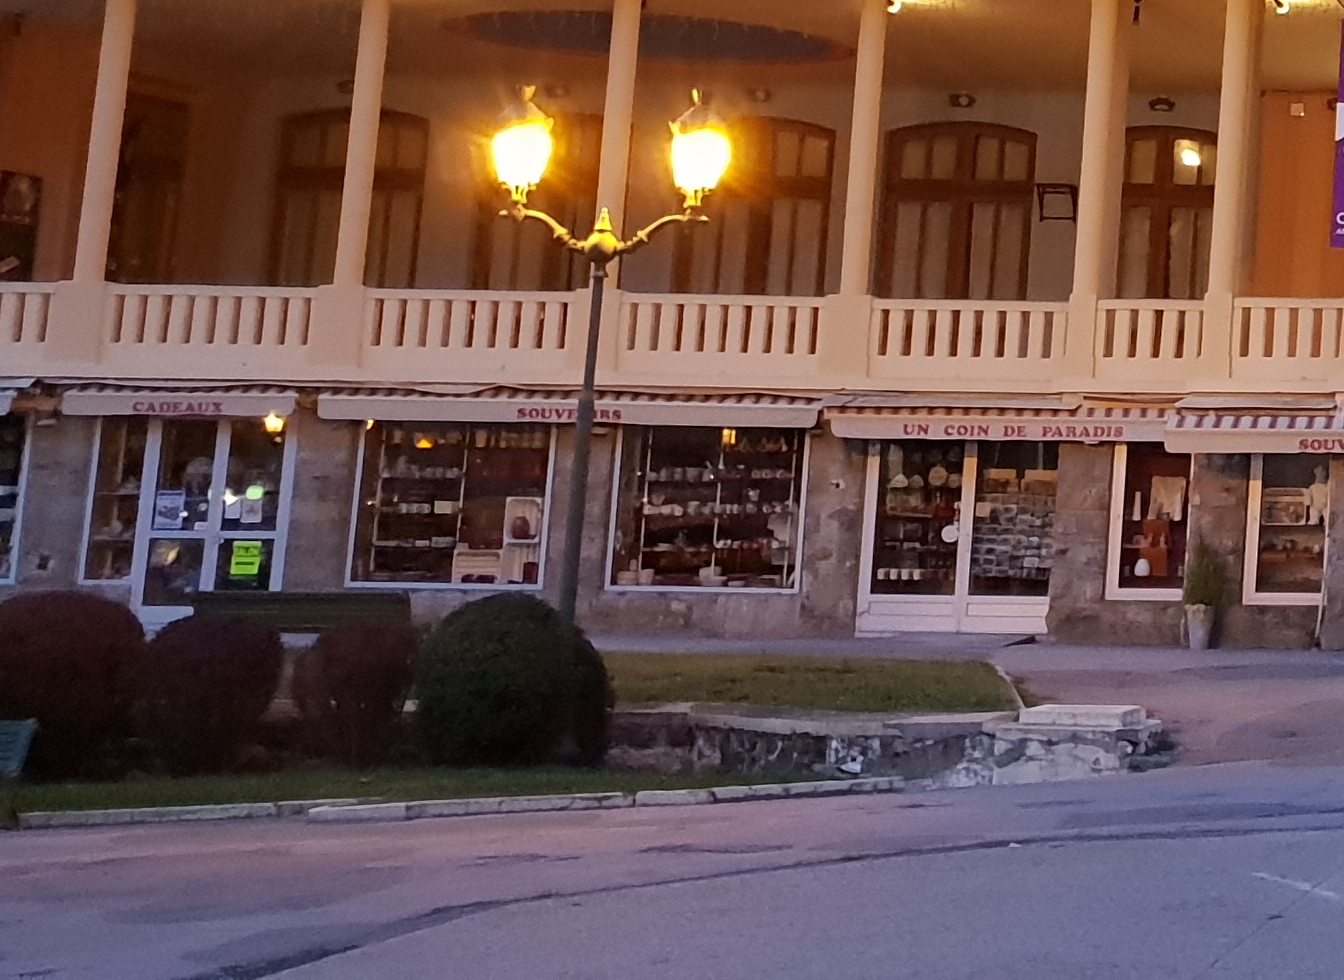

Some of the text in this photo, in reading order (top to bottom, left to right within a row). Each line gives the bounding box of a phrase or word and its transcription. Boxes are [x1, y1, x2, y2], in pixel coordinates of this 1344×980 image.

[132, 401, 223, 413] CADEAUX
[903, 423, 1125, 438] UN COIN DE PARADIS
